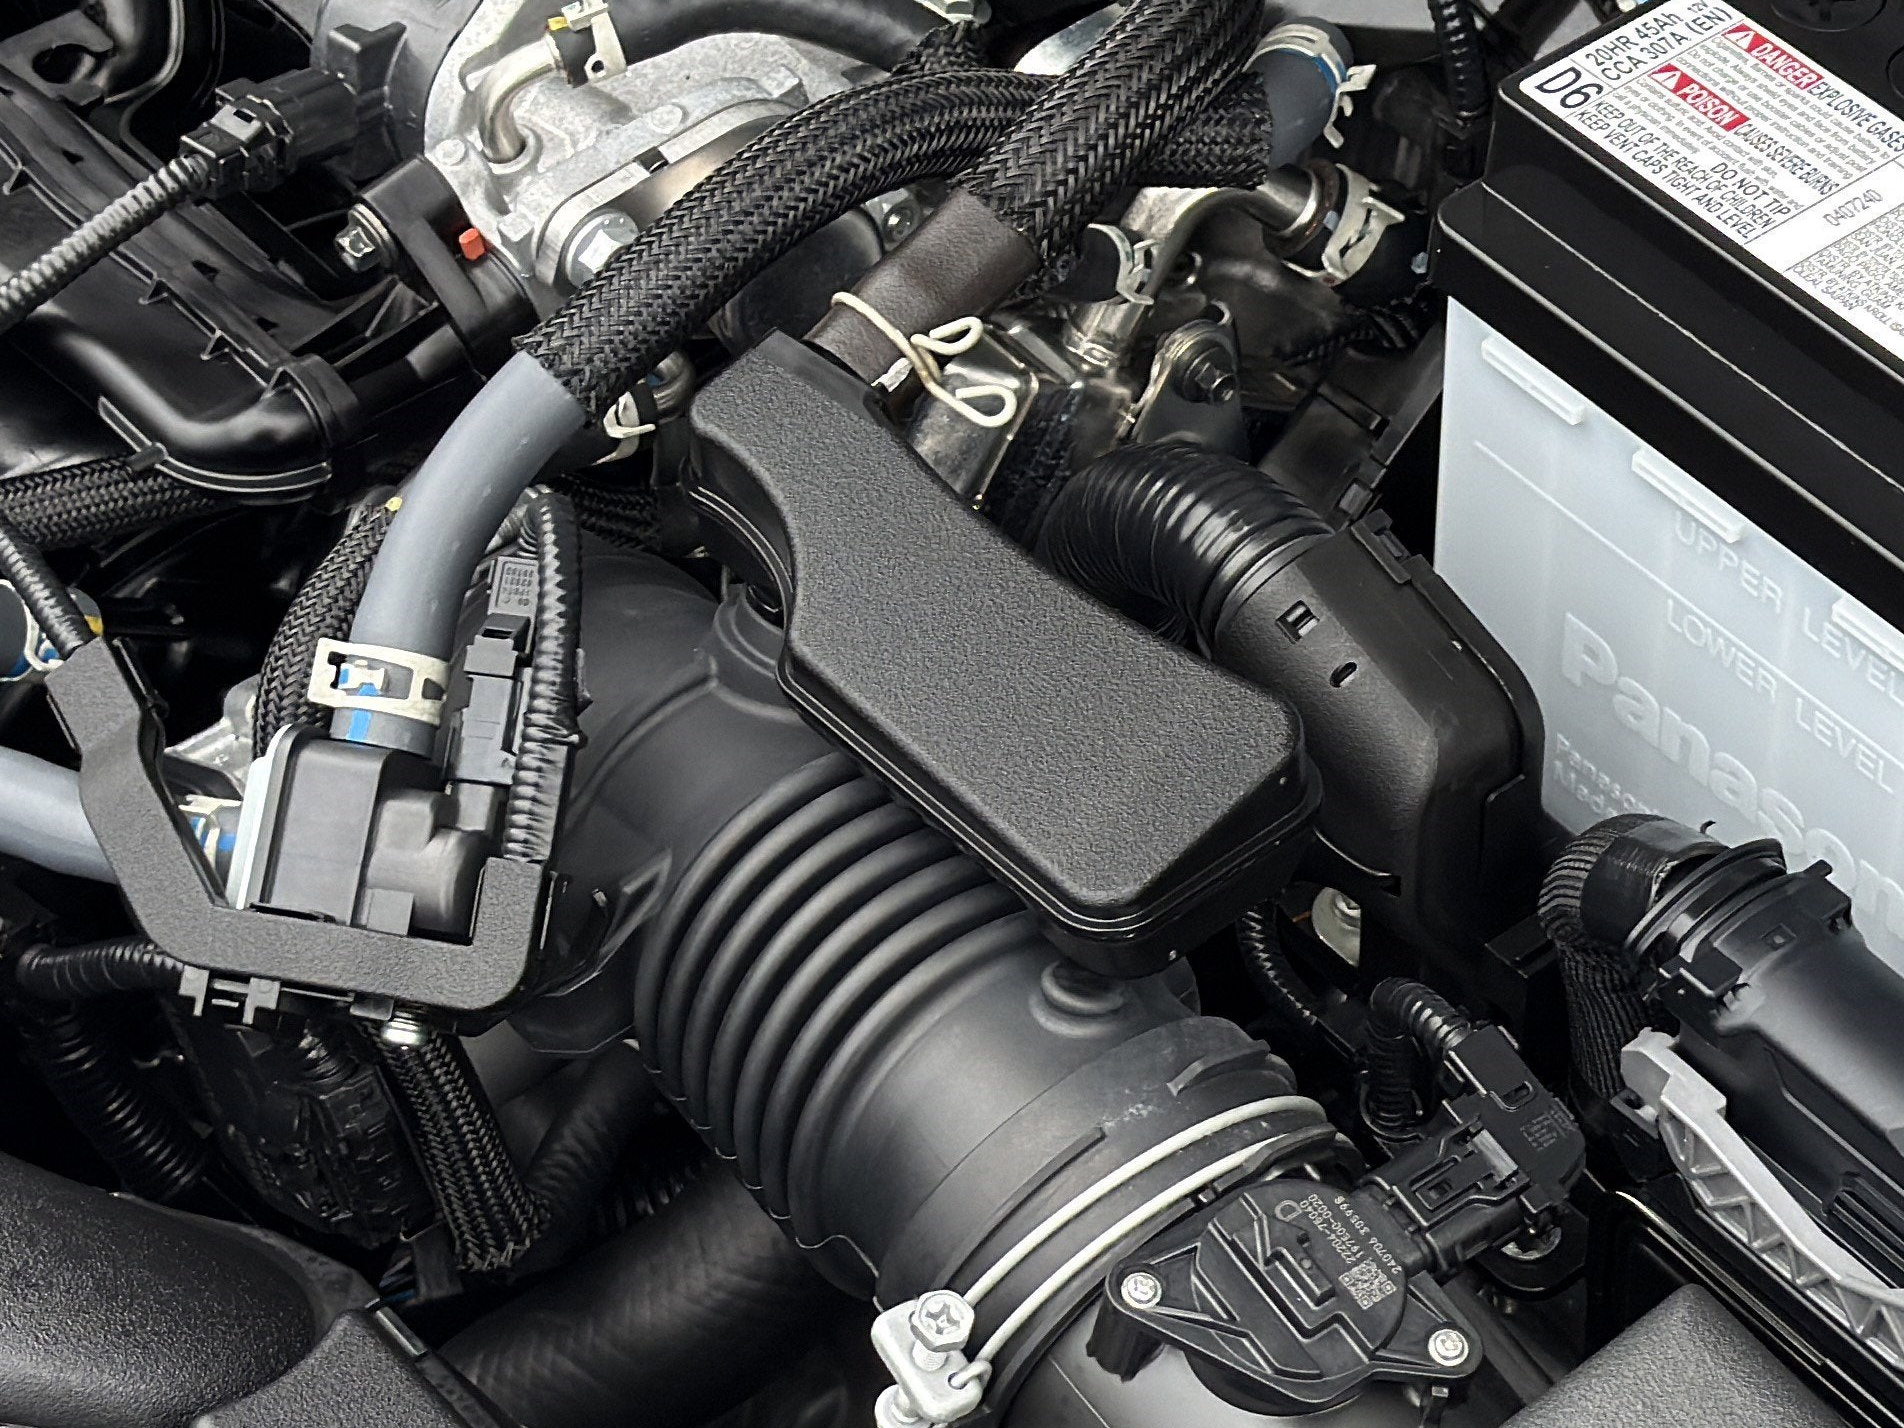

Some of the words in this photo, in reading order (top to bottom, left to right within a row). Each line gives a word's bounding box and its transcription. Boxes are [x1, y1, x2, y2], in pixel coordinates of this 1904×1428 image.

[1584, 35, 1639, 67] 20HR
[1635, 13, 1684, 39] 45Ah
[1600, 55, 1647, 81] CCA
[1639, 31, 1692, 60] 307A
[1684, 6, 1733, 36] (EN)
[1749, 42, 1818, 88] DANGER
[1533, 66, 1604, 109] D6
[1675, 82, 1740, 126] POISON
[1806, 80, 1878, 128] EXPLOSIVE
[1573, 109, 1611, 131] KEEP
[1603, 128, 1641, 153] VENT
[1631, 149, 1669, 175] CAPS
[1661, 169, 1702, 196] TIGHT
[1690, 193, 1724, 213] AND
[1715, 208, 1756, 239] LEVEL
[1592, 100, 1626, 120] KEEP
[1617, 117, 1647, 136] OUT
[1637, 132, 1661, 145] OF
[1652, 141, 1681, 162] THE
[1670, 155, 1713, 184] REACH
[1704, 179, 1729, 192] OF
[1719, 189, 1776, 229] CHILDREN
[1732, 123, 1779, 153] CAUSES
[1765, 145, 1812, 175] SEVERE
[1796, 167, 1840, 196] BURNS
[1709, 161, 1738, 181] DO
[1731, 177, 1770, 201] NOT
[1762, 197, 1792, 215] TIP
[1673, 509, 1784, 616] UPPER
[1667, 598, 1777, 700] LOWER
[1797, 697, 1895, 794] LEVEL
[1274, 1199, 1303, 1223] D
